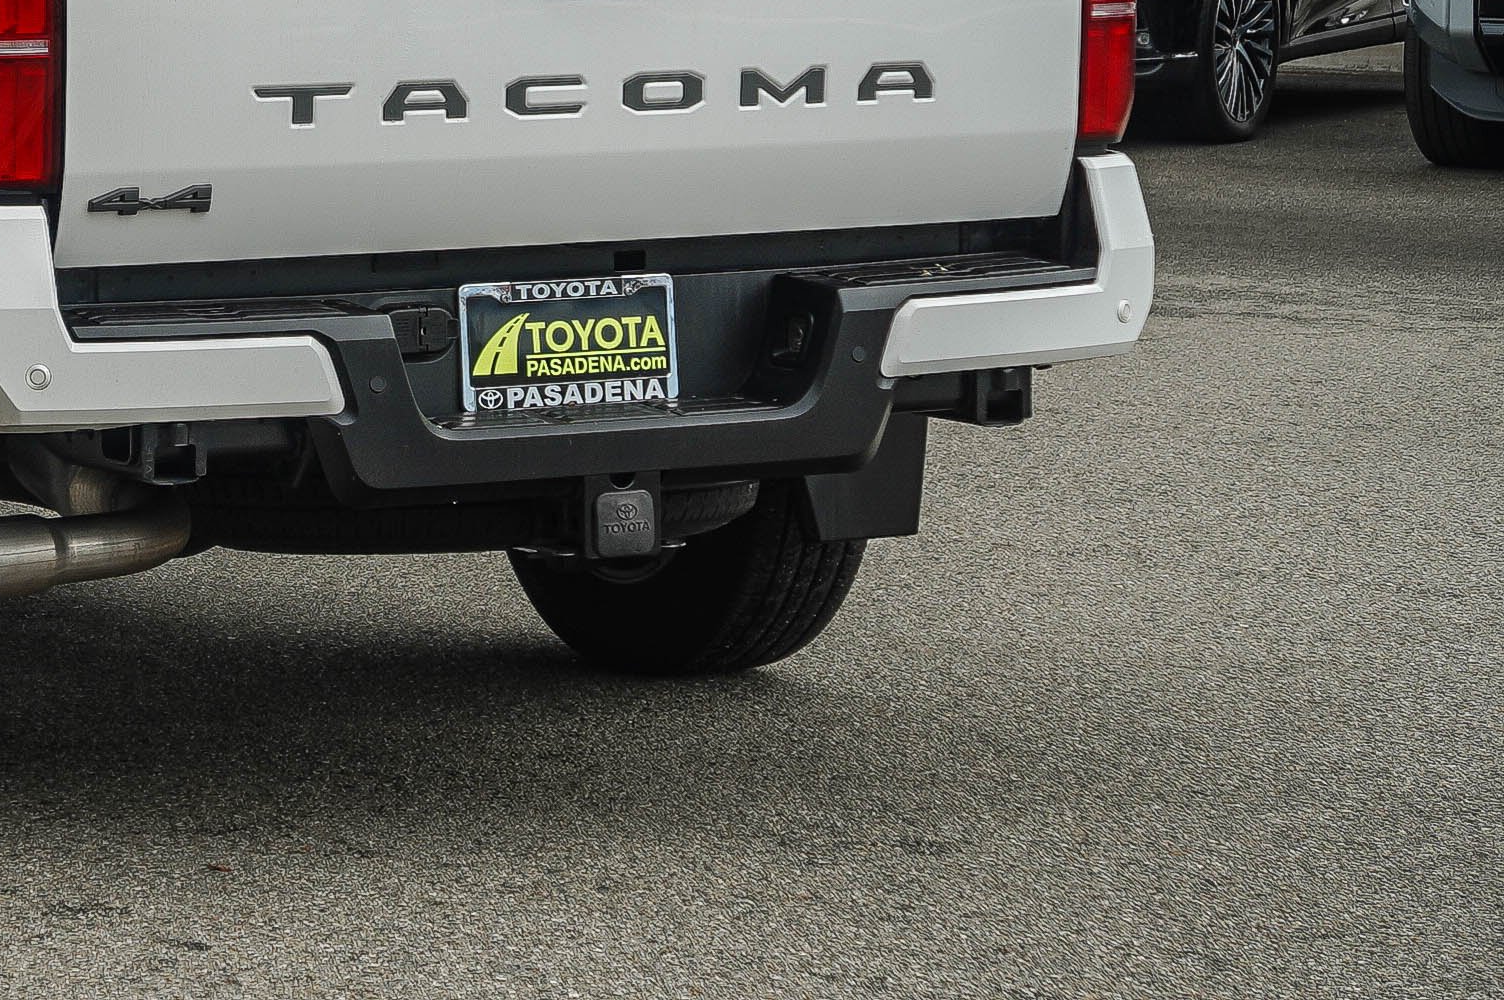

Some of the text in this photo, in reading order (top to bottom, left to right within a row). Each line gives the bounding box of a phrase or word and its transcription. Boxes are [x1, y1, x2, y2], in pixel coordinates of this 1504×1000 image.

[251, 60, 936, 128] TACOMA
[515, 279, 618, 301] TOYOTA
[525, 315, 666, 354] TOYOTA
[526, 355, 667, 377] PASADENA.com
[506, 378, 666, 410] PASADENA
[603, 519, 650, 534] TOYOTA
